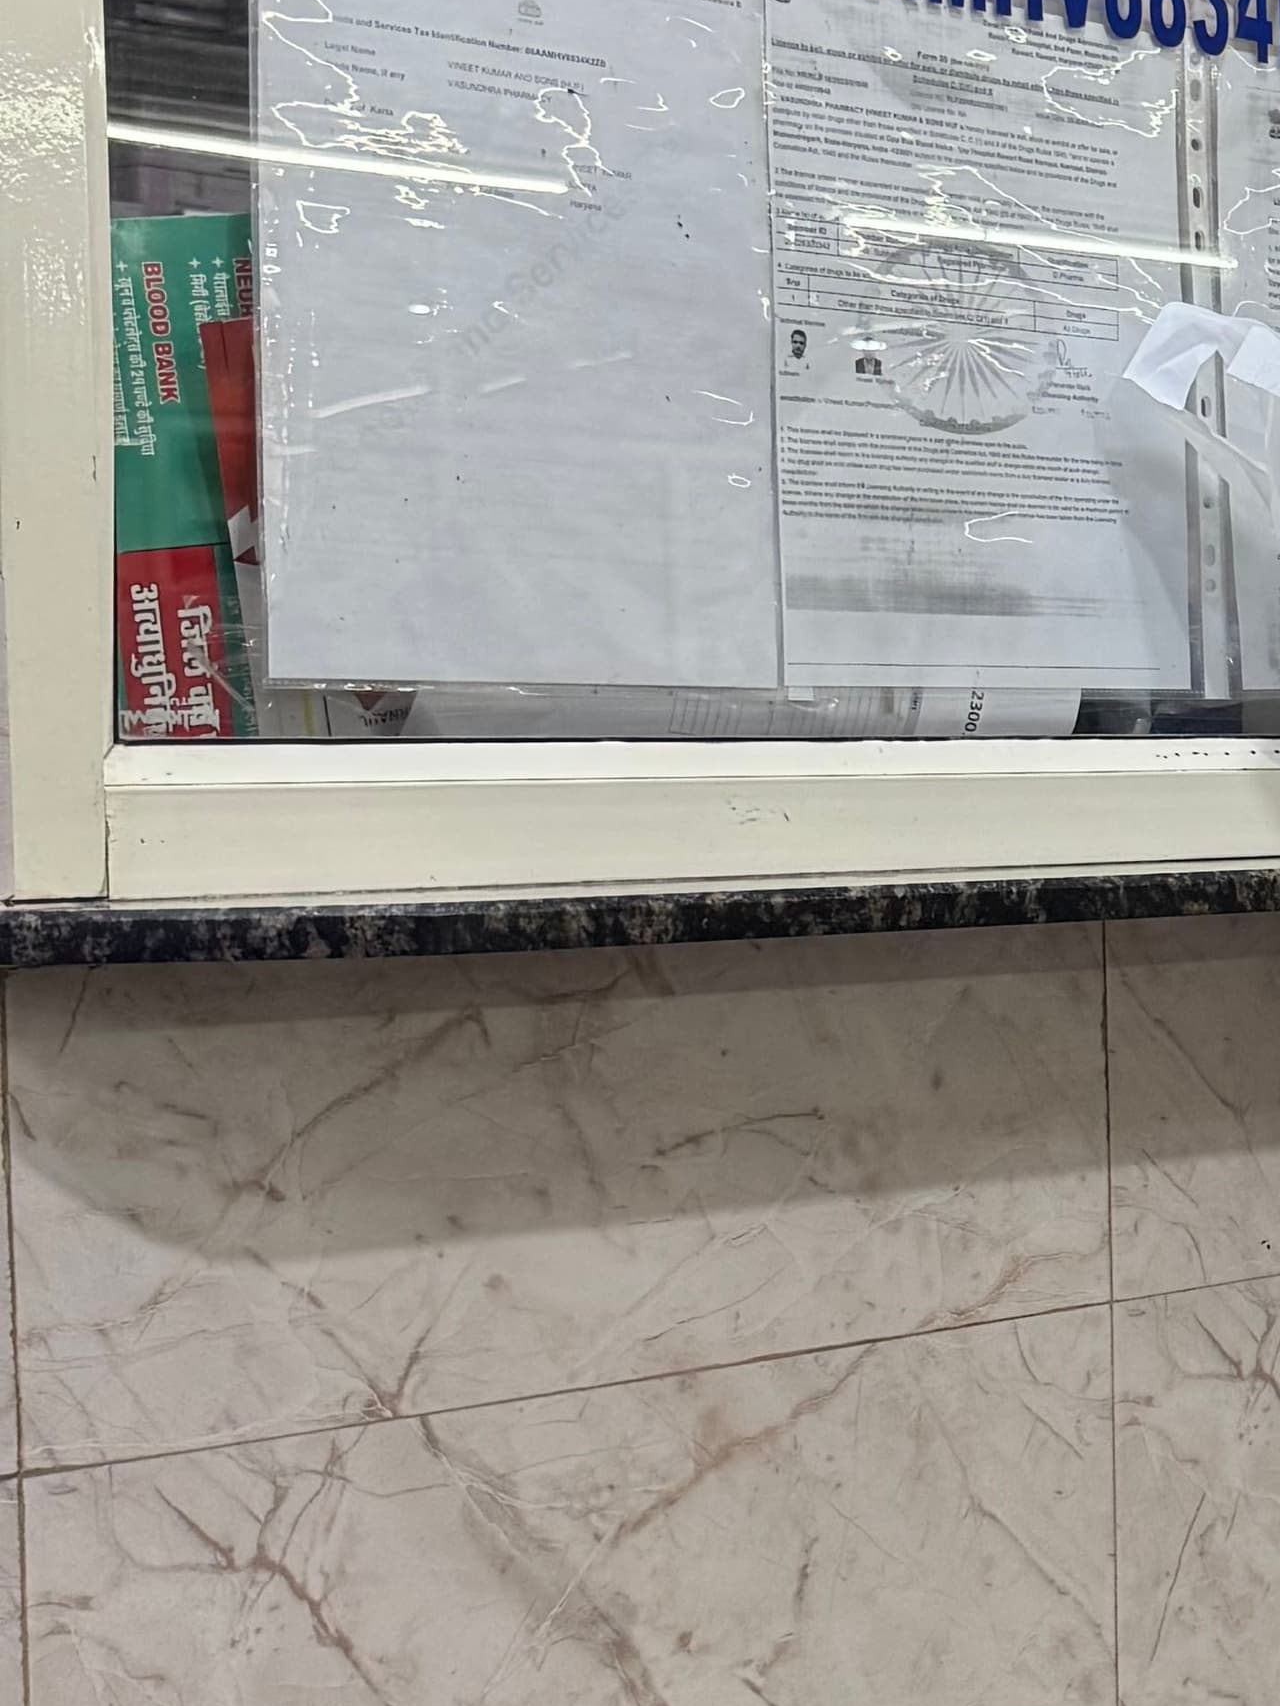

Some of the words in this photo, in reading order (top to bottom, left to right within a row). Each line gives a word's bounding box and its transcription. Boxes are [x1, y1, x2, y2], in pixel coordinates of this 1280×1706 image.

[375, 20, 412, 34] Services
[448, 60, 479, 73] VINEET
[141, 261, 171, 337] BLOOD
[153, 342, 180, 405] BANK
